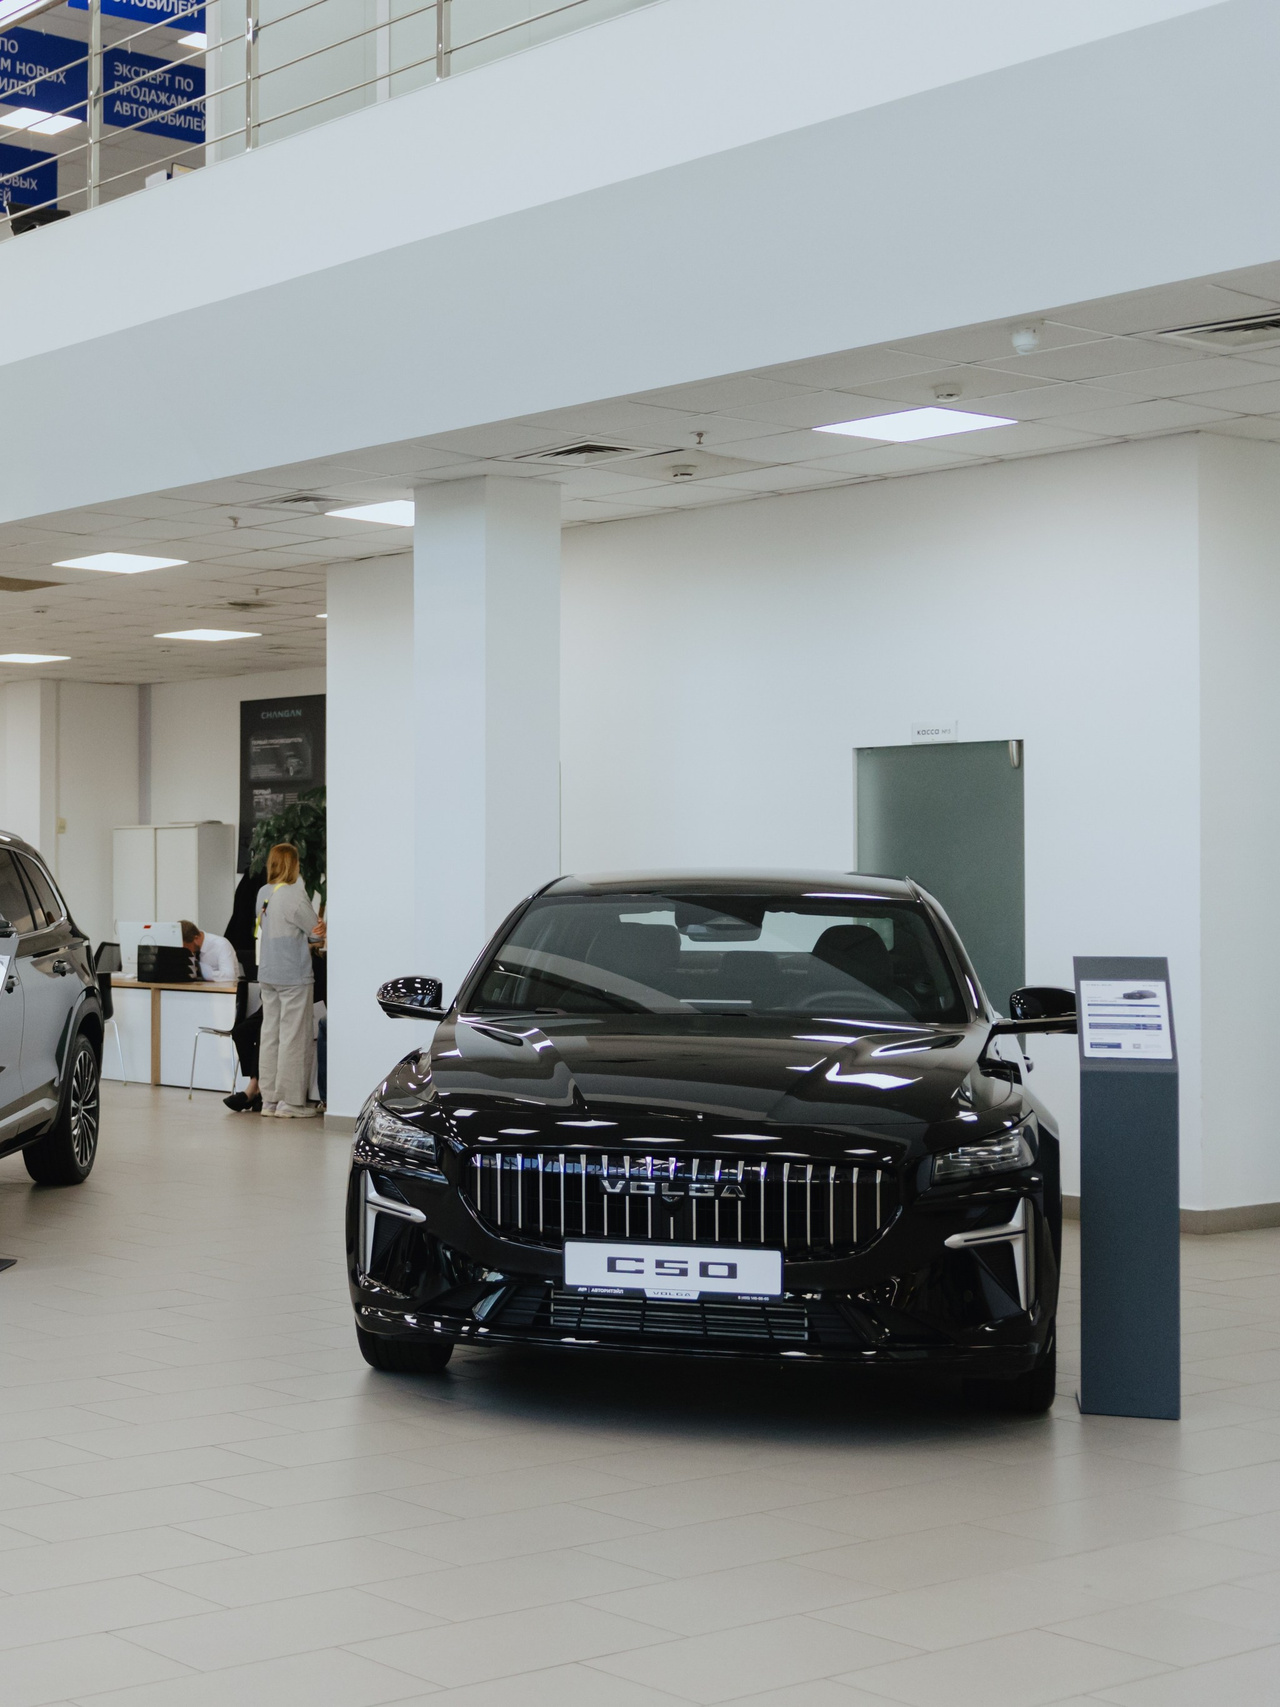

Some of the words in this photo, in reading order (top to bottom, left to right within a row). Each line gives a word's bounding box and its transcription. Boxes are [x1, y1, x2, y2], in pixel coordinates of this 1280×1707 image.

[16, 60, 66, 85] НОВЫХ
[175, 75, 194, 92] ПО
[261, 709, 302, 720] CHANGAN
[600, 1179, 746, 1198] VOLGA
[606, 1256, 738, 1279] C50
